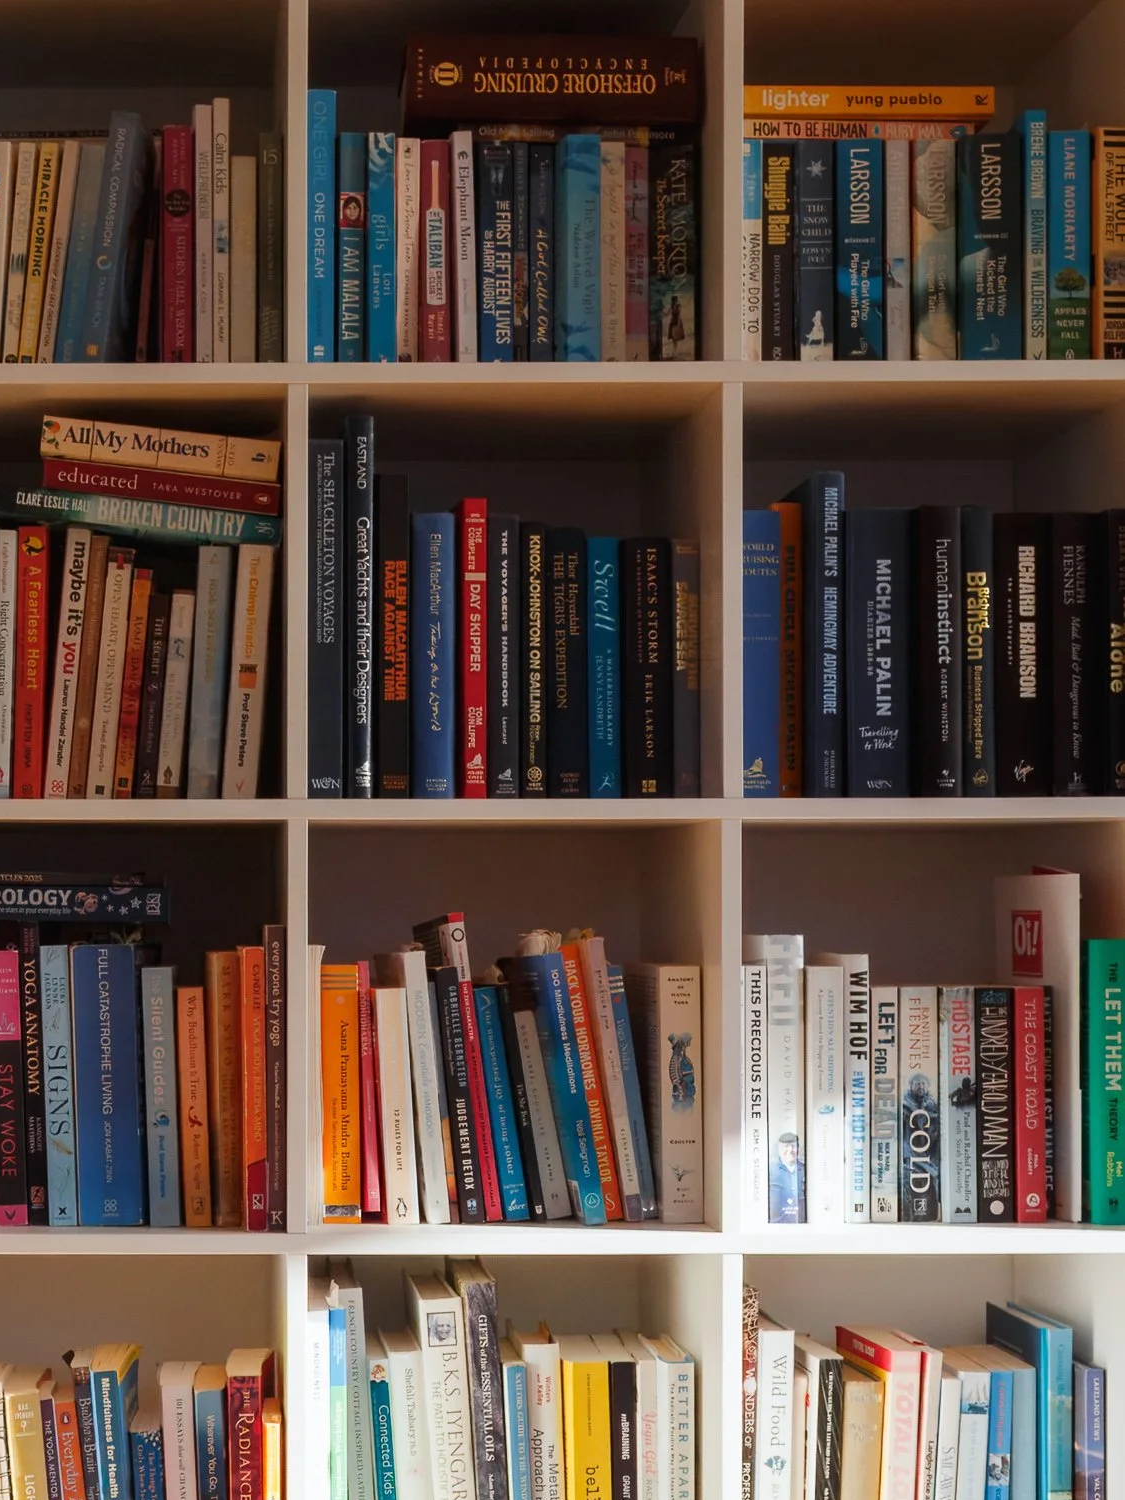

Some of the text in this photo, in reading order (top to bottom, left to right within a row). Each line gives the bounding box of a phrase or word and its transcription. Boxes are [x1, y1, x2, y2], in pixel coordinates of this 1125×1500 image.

[474, 72, 656, 94] OFFSHORE CRUISING
[479, 57, 648, 70] ENCYCLOPEDIA
[762, 89, 943, 110] lighter yung pueblo
[215, 133, 227, 194] Calm Kids
[313, 101, 326, 141] ONE
[753, 122, 868, 138] HOW TO BE HUMAN
[37, 158, 52, 213] MIRACLE
[102, 128, 126, 247] RADICAL COMPASSION
[313, 146, 327, 184] GIRL
[314, 192, 324, 222] ONE
[764, 156, 791, 245] Shuggie Bain
[850, 148, 870, 224] LARSSON
[1064, 137, 1075, 261] LIANE MORIARTY
[31, 217, 46, 277] MORNING
[314, 228, 325, 278] DREAM
[456, 166, 470, 261] Elephant Moon
[668, 159, 687, 293] KATE MORTON
[343, 246, 358, 272] AM
[483, 241, 494, 315] HARRY AUGUST
[495, 211, 511, 344] FIRST FIFTEEN LIVES
[341, 279, 359, 340] MALALA
[58, 468, 138, 490] educated
[63, 426, 210, 458] All My Mothers
[357, 436, 367, 489] EASTLAND
[98, 498, 246, 537] BROKEN COUNTRY
[323, 453, 335, 644] The SHACKLETON VOYAGES
[27, 566, 41, 689] A Fearless Heart
[62, 541, 86, 674] maybe it's you
[353, 517, 371, 724] Great Yachts and their Designers
[470, 584, 481, 672] DAY SKIPPER
[529, 535, 540, 723] KNOX-JOHNSTON ON SAILING
[593, 560, 616, 632] Swell
[823, 487, 838, 715] MICHAEL PALIN'S HEMINGWAY ADVENTURE
[875, 559, 891, 717] MICHAEL PALIN
[1018, 545, 1036, 698] RICHARD BRANSON
[97, 948, 112, 1115] FULL CATASTROPHE LIVING
[270, 941, 282, 1046] everyone try yoga
[564, 959, 596, 1091] HACK YOUR HORMONES
[849, 971, 868, 1060] WIM HOF
[751, 970, 762, 1119] THIS PRECIOUS ISLE
[874, 1002, 896, 1138] LEFT FOR DEAD
[951, 1000, 971, 1076] HOSTAGE
[1104, 988, 1122, 1091] LET THEM
[47, 1045, 71, 1136] SIGNS
[0, 1120, 16, 1177] WOKE
[455, 1098, 474, 1191] JUDGEMENT DETOX
[909, 1108, 931, 1194] COLD
[441, 1351, 461, 1402] B.K.S.
[677, 1373, 689, 1443] BETTER
[770, 1355, 788, 1446] Wild Food
[377, 1405, 395, 1495] Connected Kids
[532, 1429, 548, 1492] Approach
